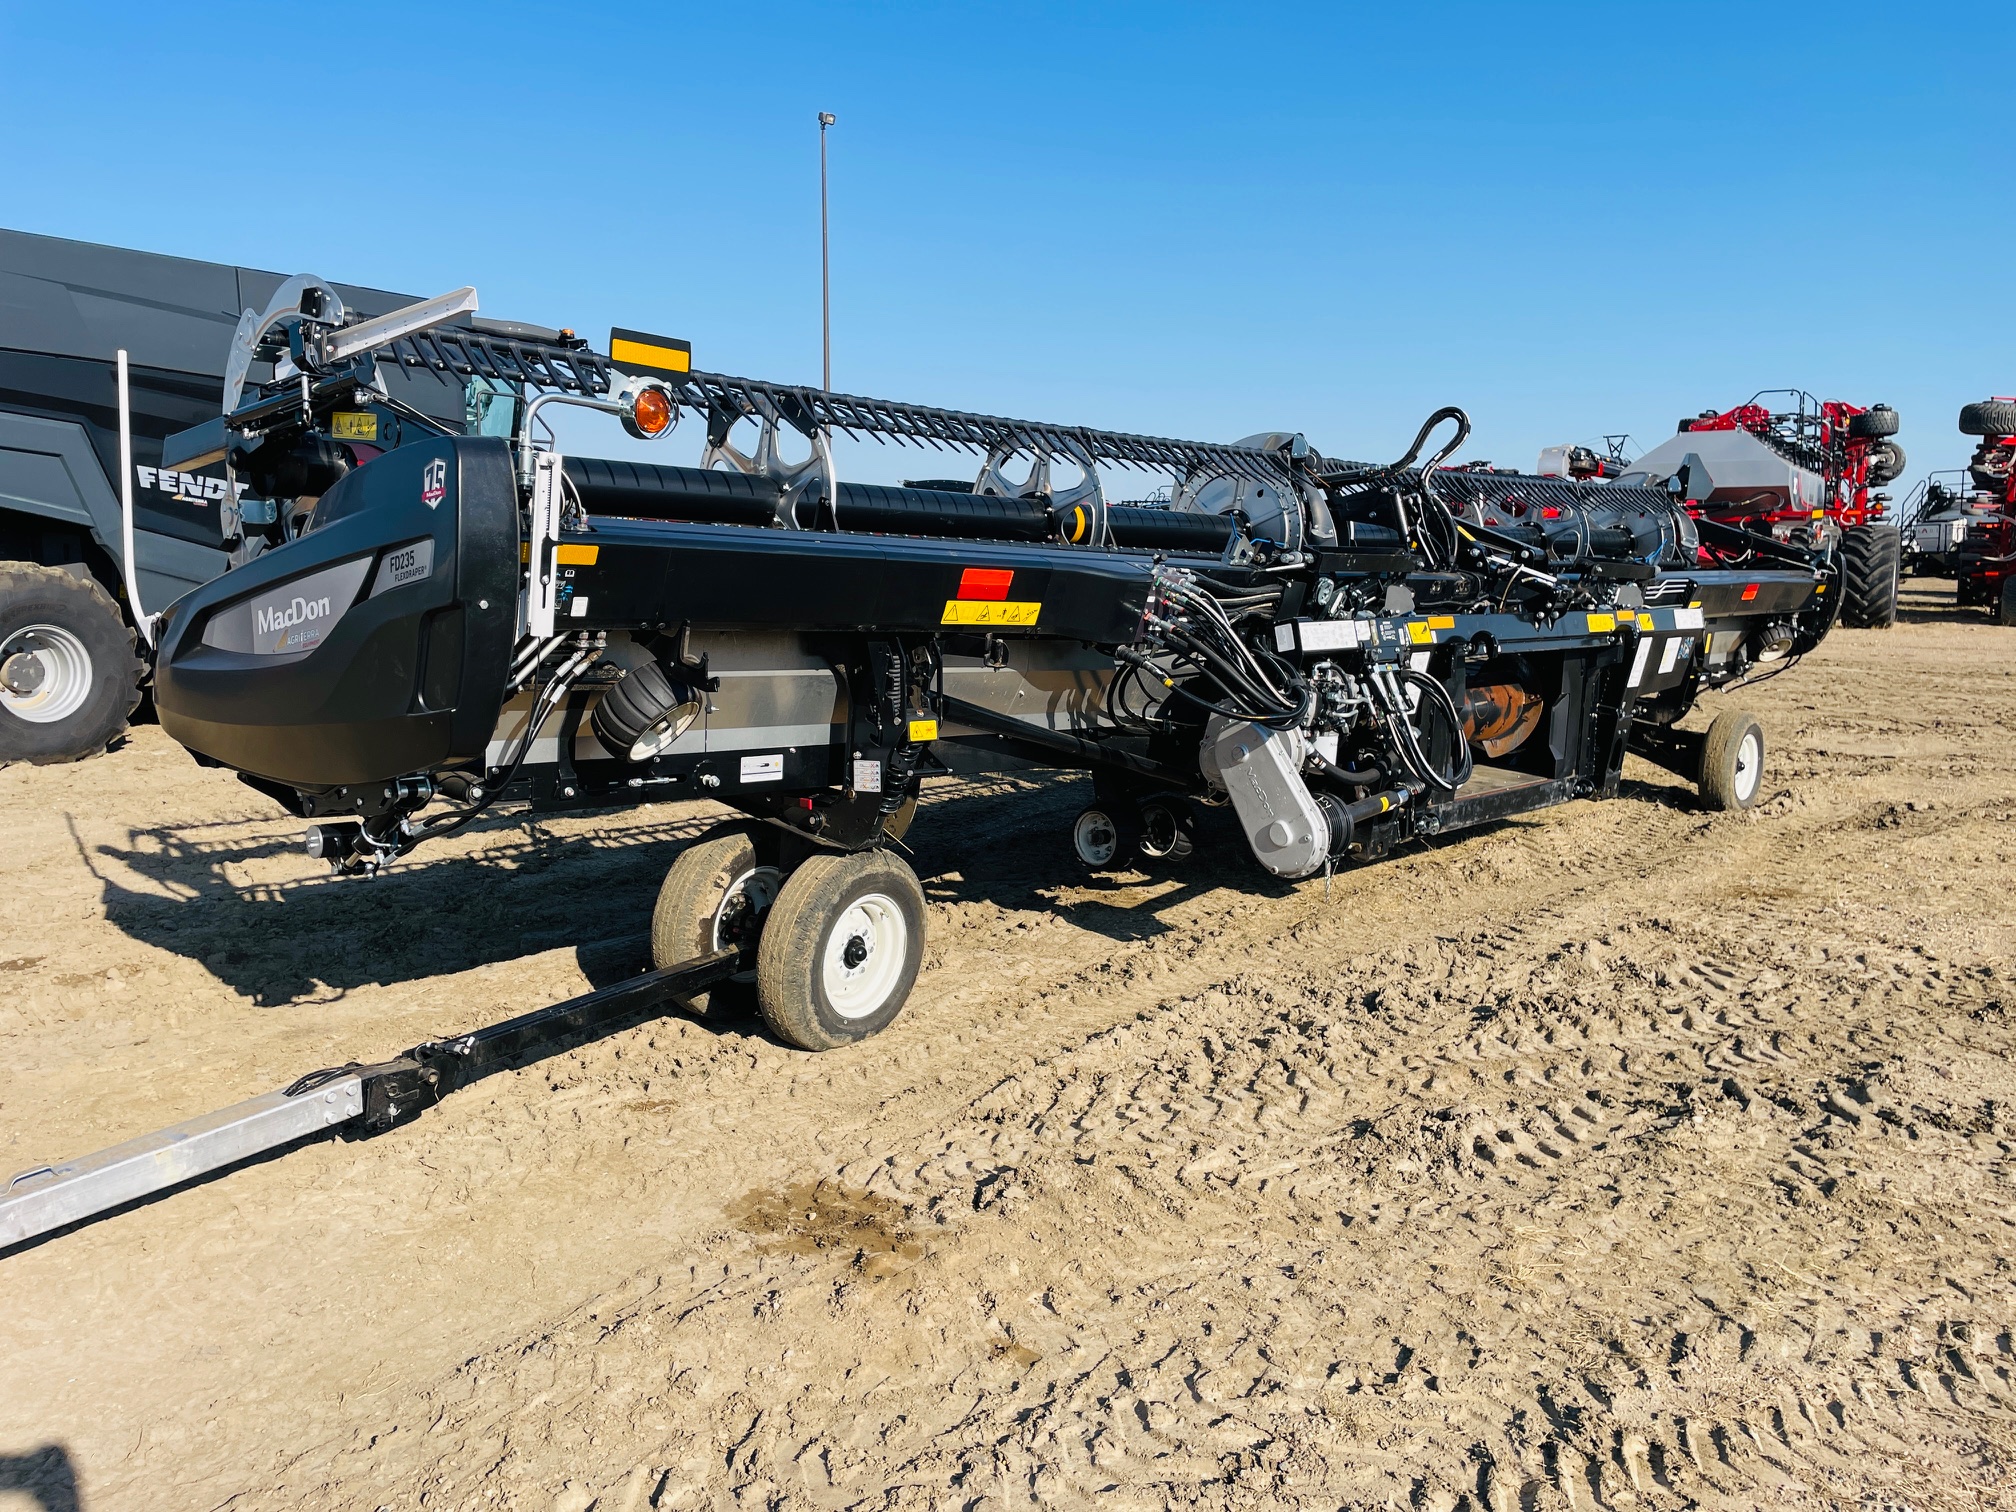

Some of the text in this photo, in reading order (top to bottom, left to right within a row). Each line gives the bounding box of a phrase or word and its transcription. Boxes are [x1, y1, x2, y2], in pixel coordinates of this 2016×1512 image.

[136, 465, 250, 501] FENDT
[390, 550, 415, 573] FD235
[258, 597, 330, 635] MacDon
[1246, 766, 1275, 819] MacDon
